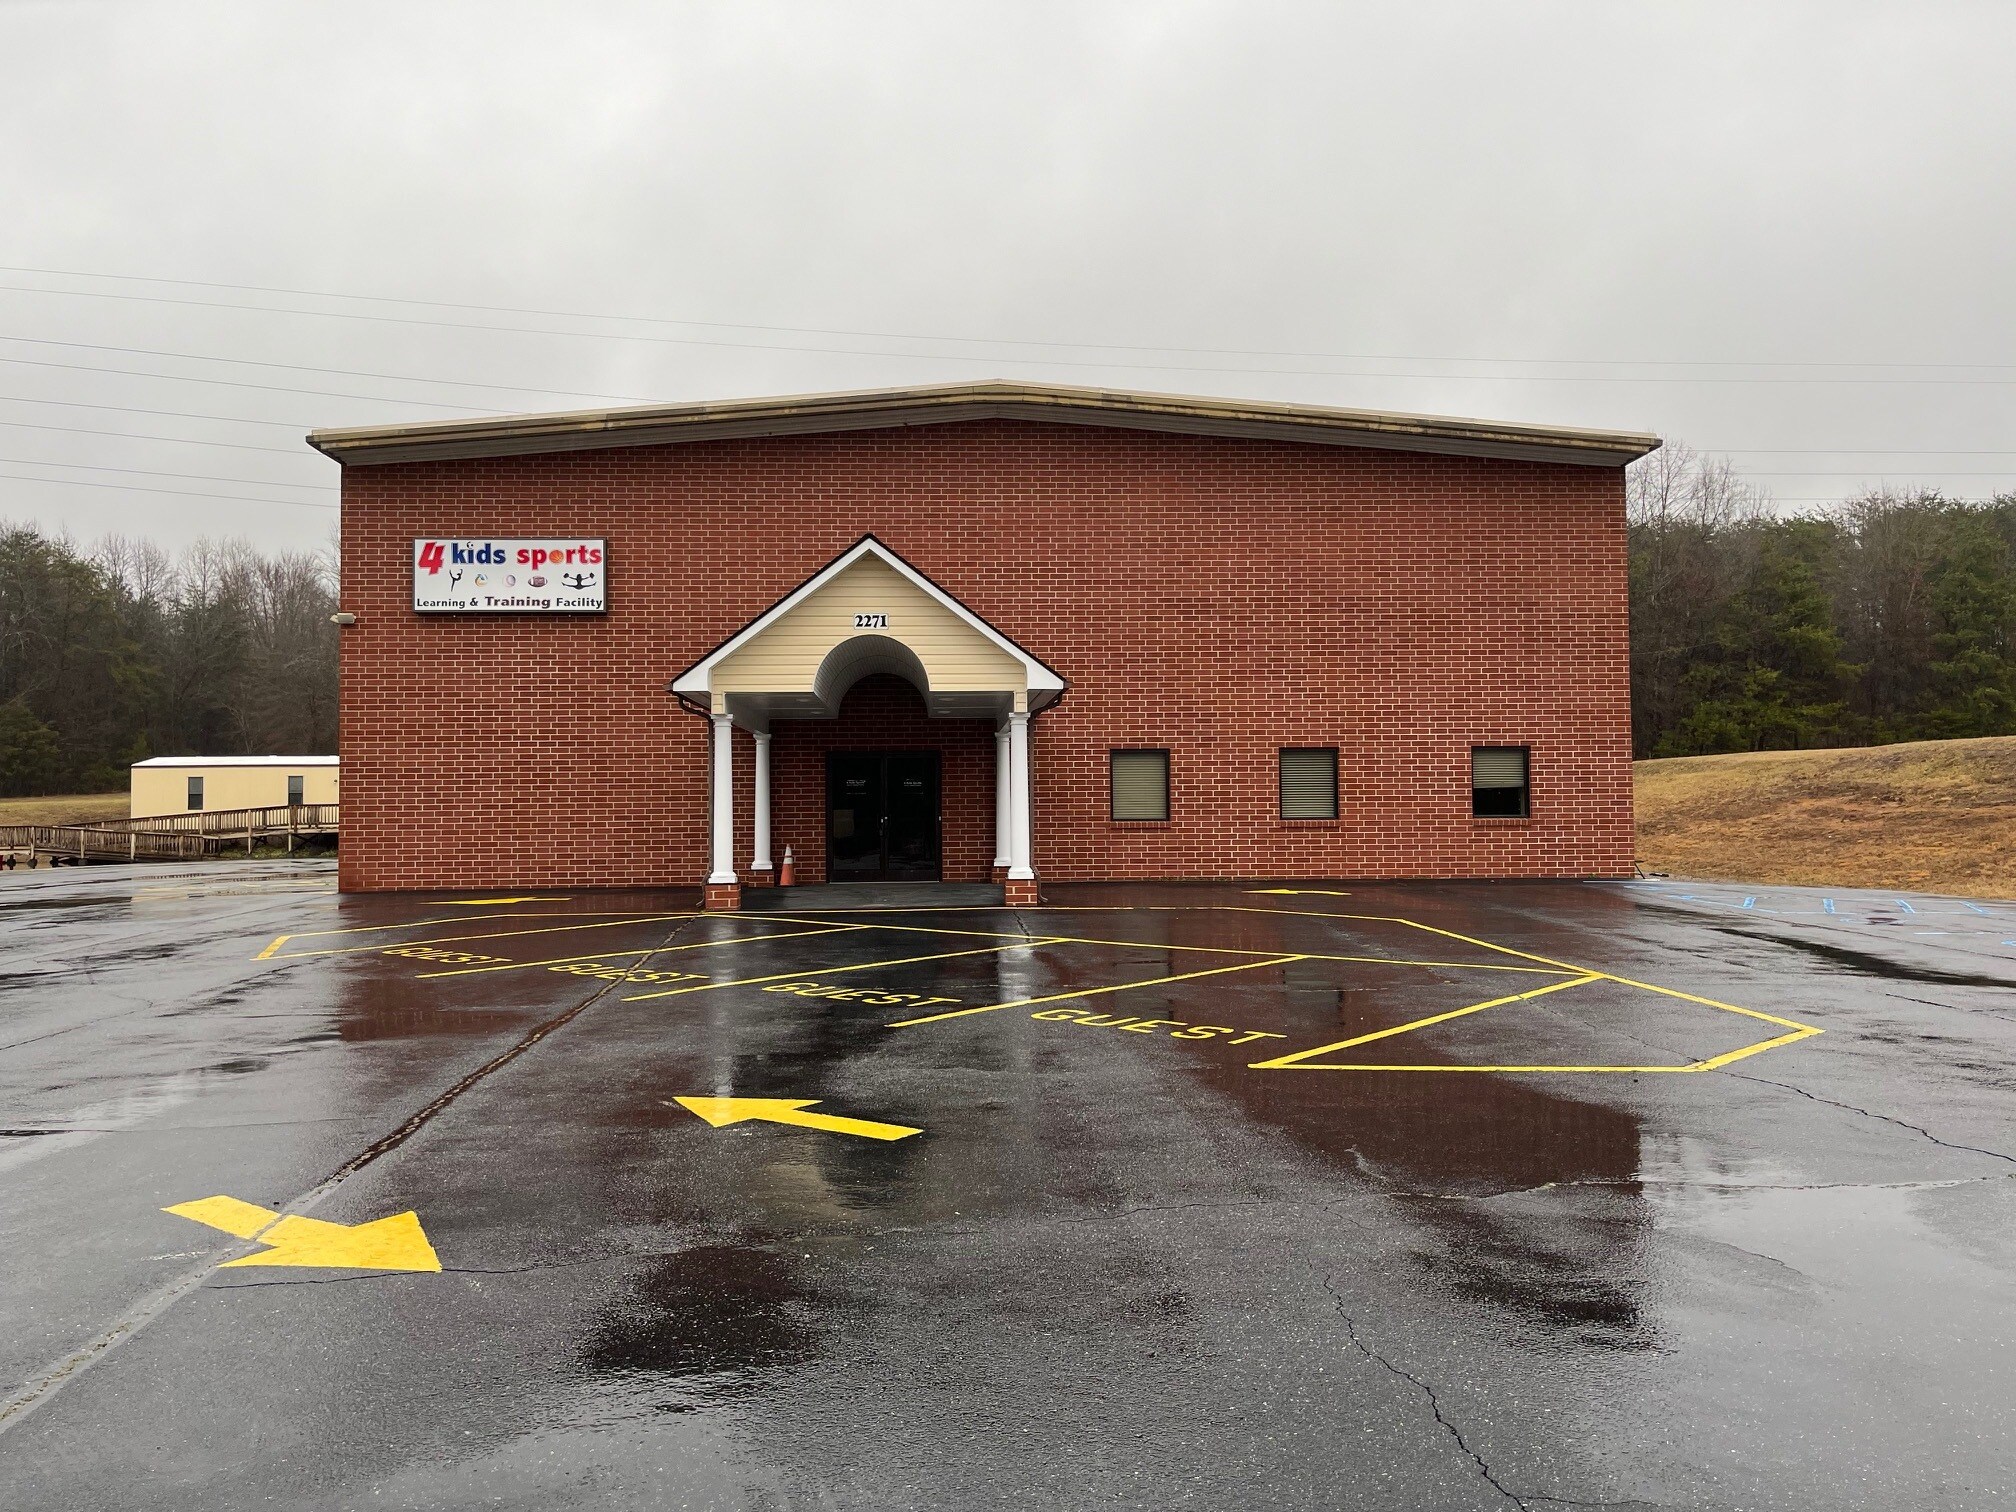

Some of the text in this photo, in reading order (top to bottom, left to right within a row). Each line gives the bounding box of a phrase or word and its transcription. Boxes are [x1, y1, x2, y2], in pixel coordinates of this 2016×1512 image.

[418, 540, 602, 576] 4 kids sports
[417, 596, 603, 610] Learning & Training Facility
[855, 615, 887, 628] 2271
[382, 946, 513, 966] GUEST
[547, 963, 711, 984] GUEST
[762, 981, 963, 1008] GUEST
[1030, 1008, 1288, 1046] GUEST
